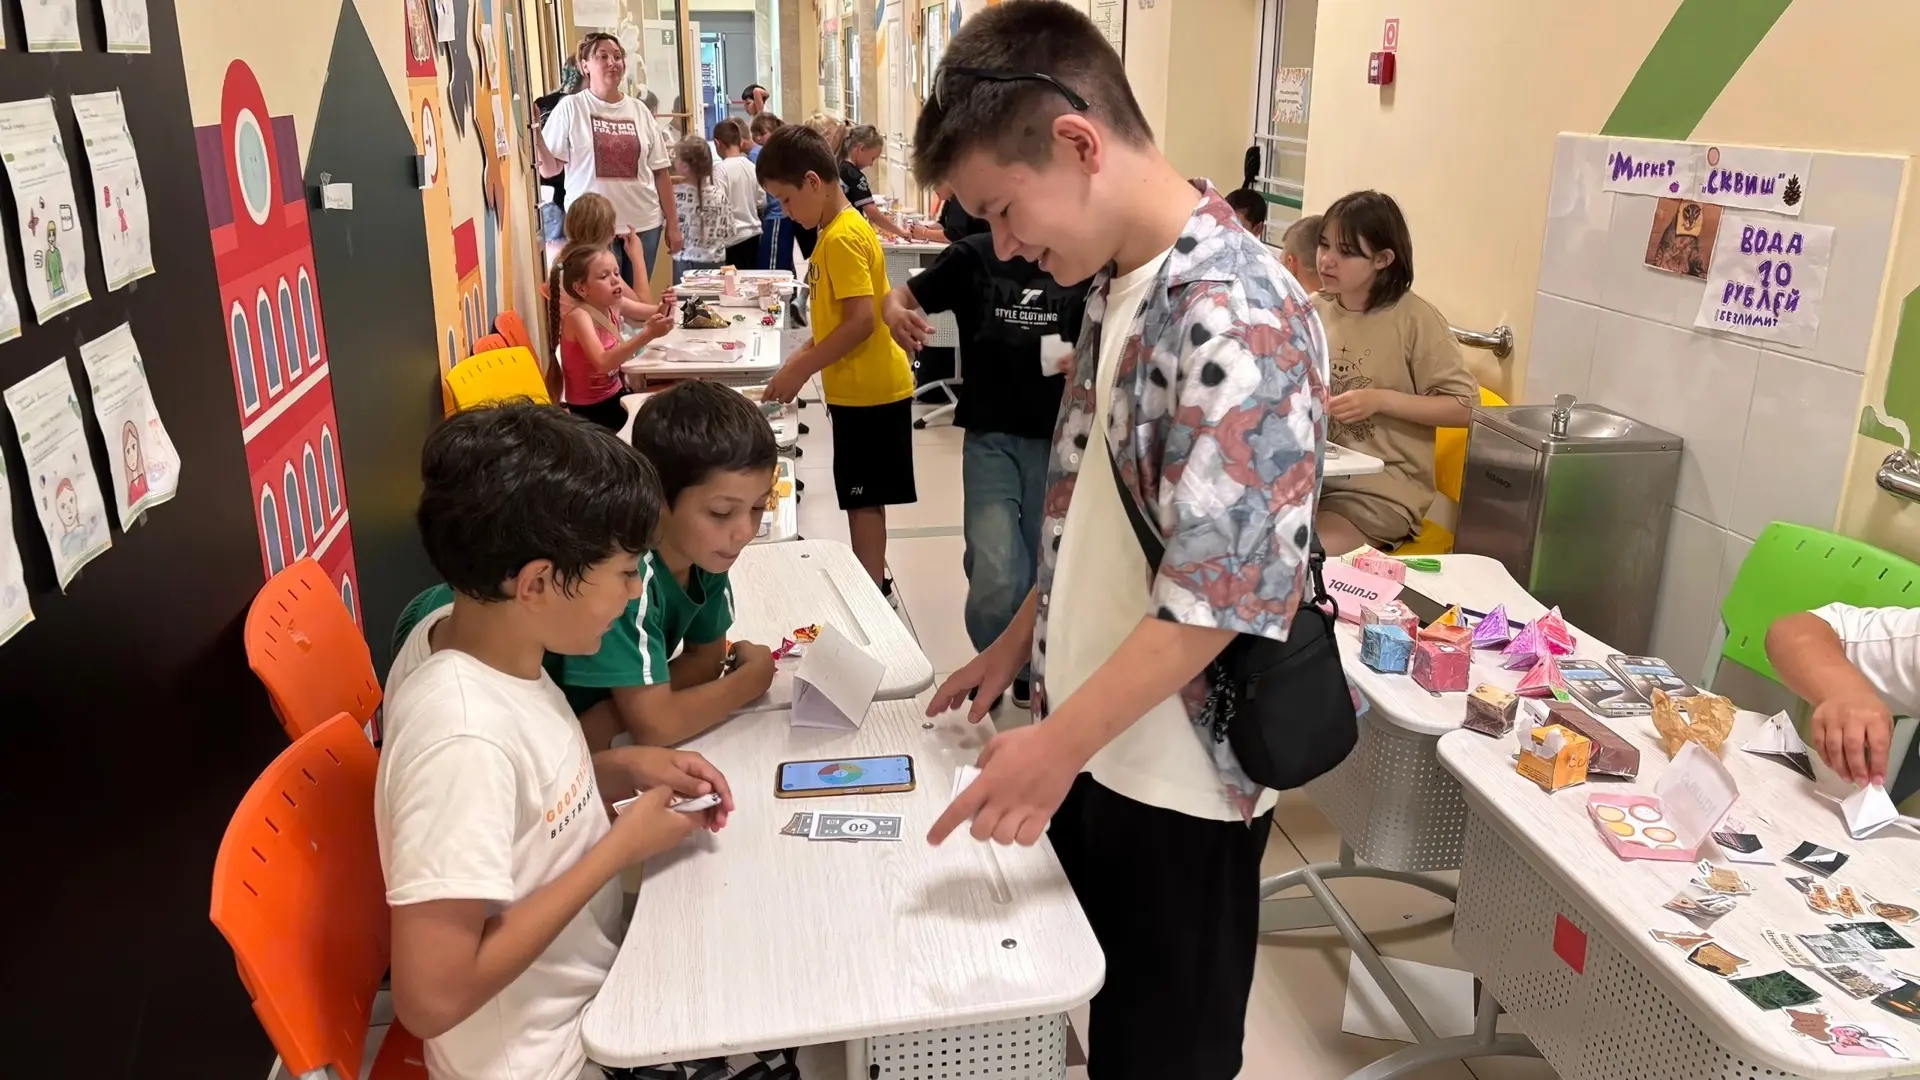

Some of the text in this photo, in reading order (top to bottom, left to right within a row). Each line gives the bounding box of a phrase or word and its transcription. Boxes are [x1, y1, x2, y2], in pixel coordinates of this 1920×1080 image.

[1741, 225, 1803, 255] ВОДА
[1757, 260, 1792, 288] 10
[1722, 282, 1800, 317] РУБЛЕЙ
[995, 308, 1058, 321] STYLE CLOTHING
[1328, 579, 1378, 601] crumbl
[849, 823, 868, 832] 50
